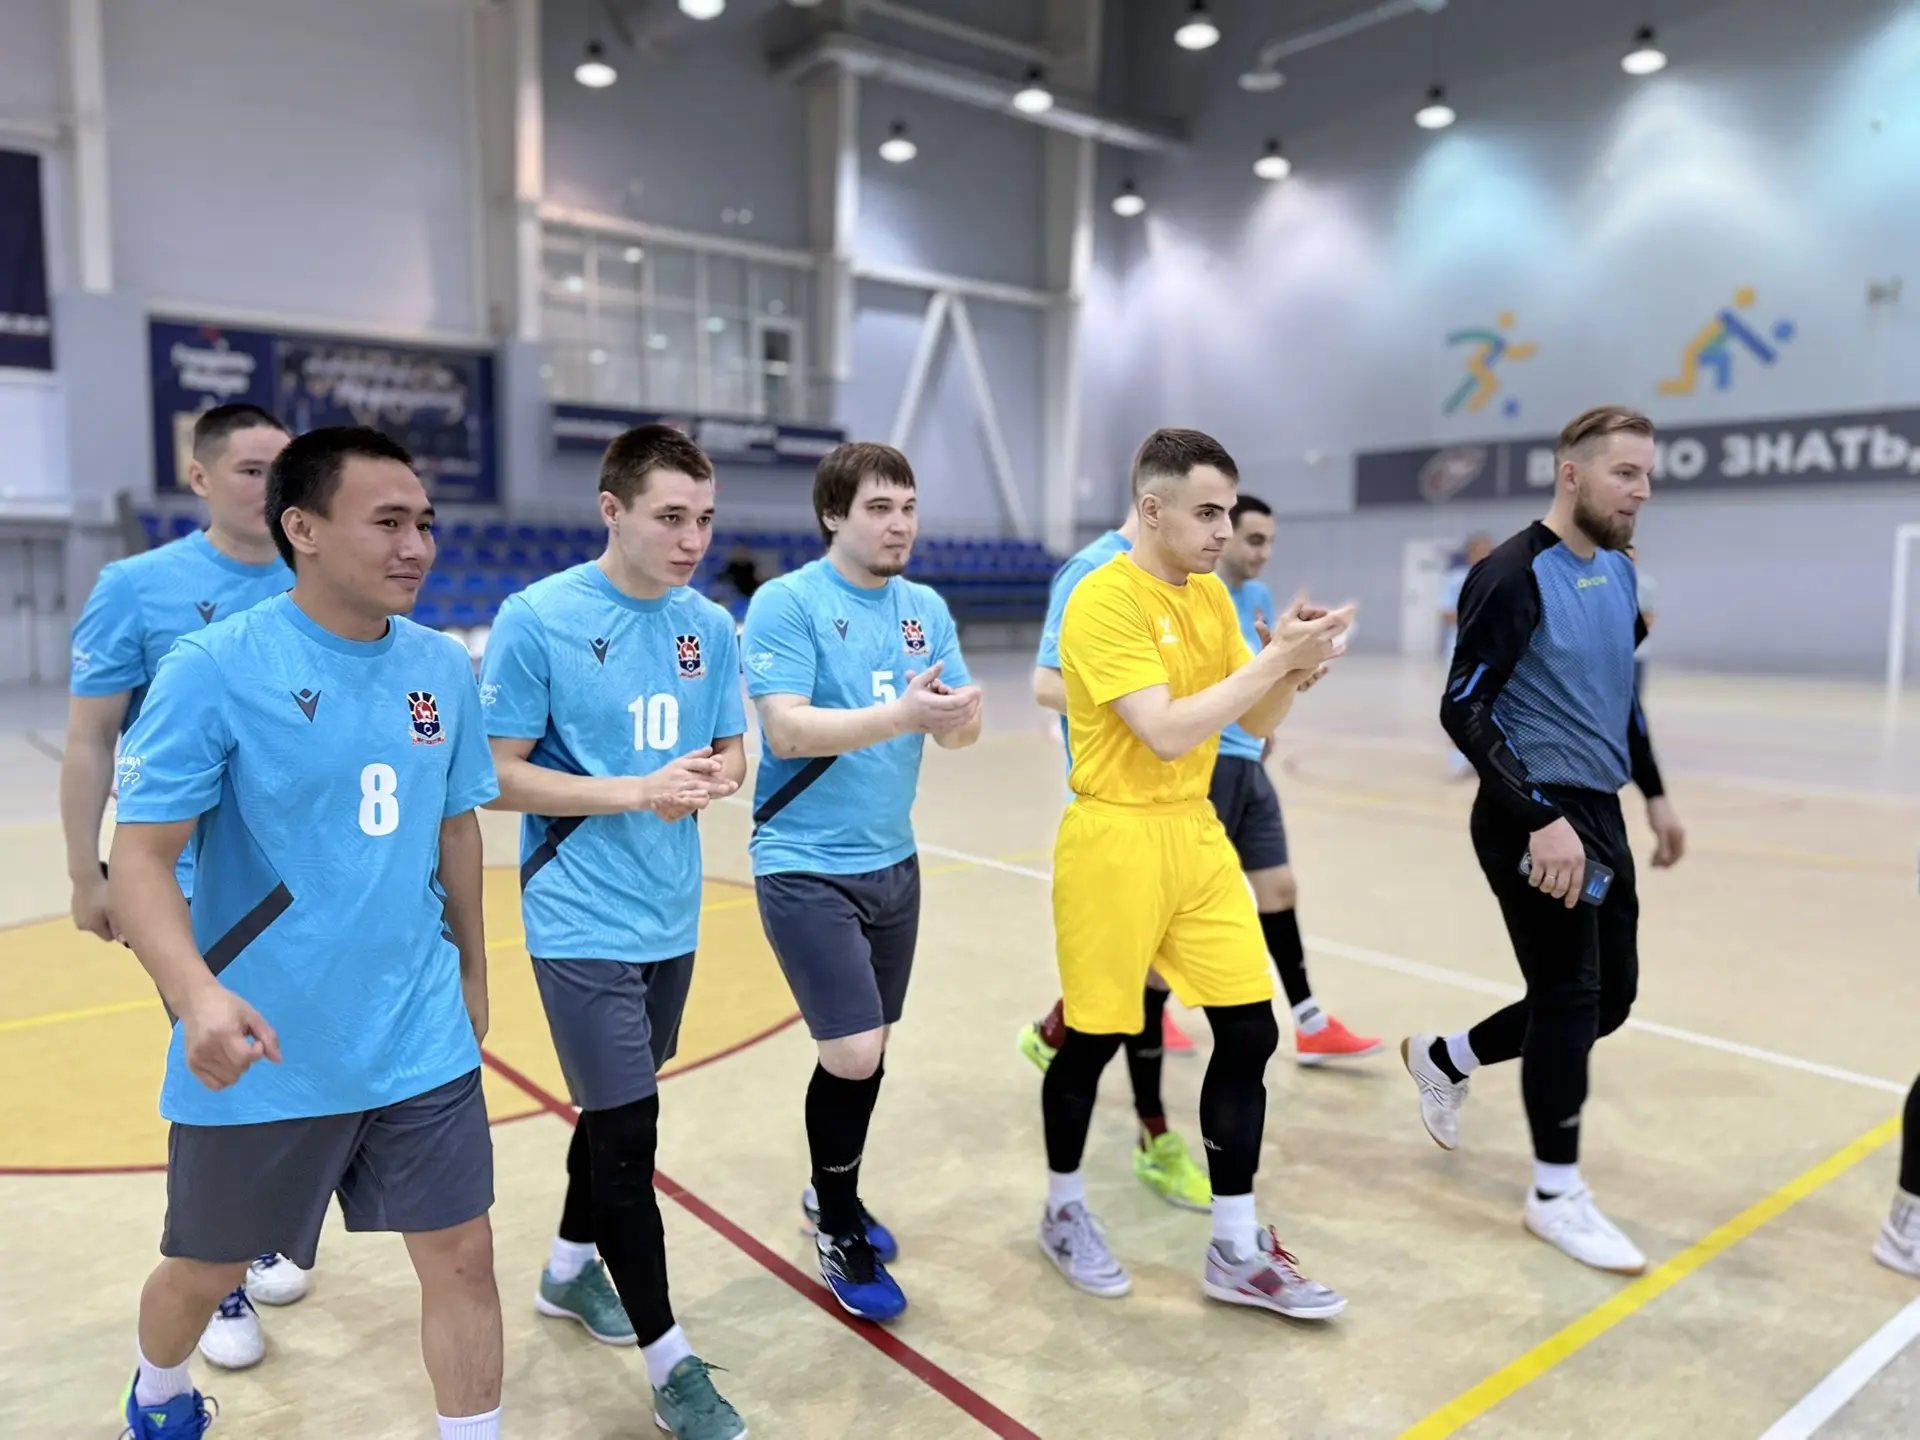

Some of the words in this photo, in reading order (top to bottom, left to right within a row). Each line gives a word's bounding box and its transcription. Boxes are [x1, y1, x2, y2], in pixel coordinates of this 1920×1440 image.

[872, 670, 897, 704] 5
[628, 693, 678, 751] 10
[359, 763, 399, 836] 8
